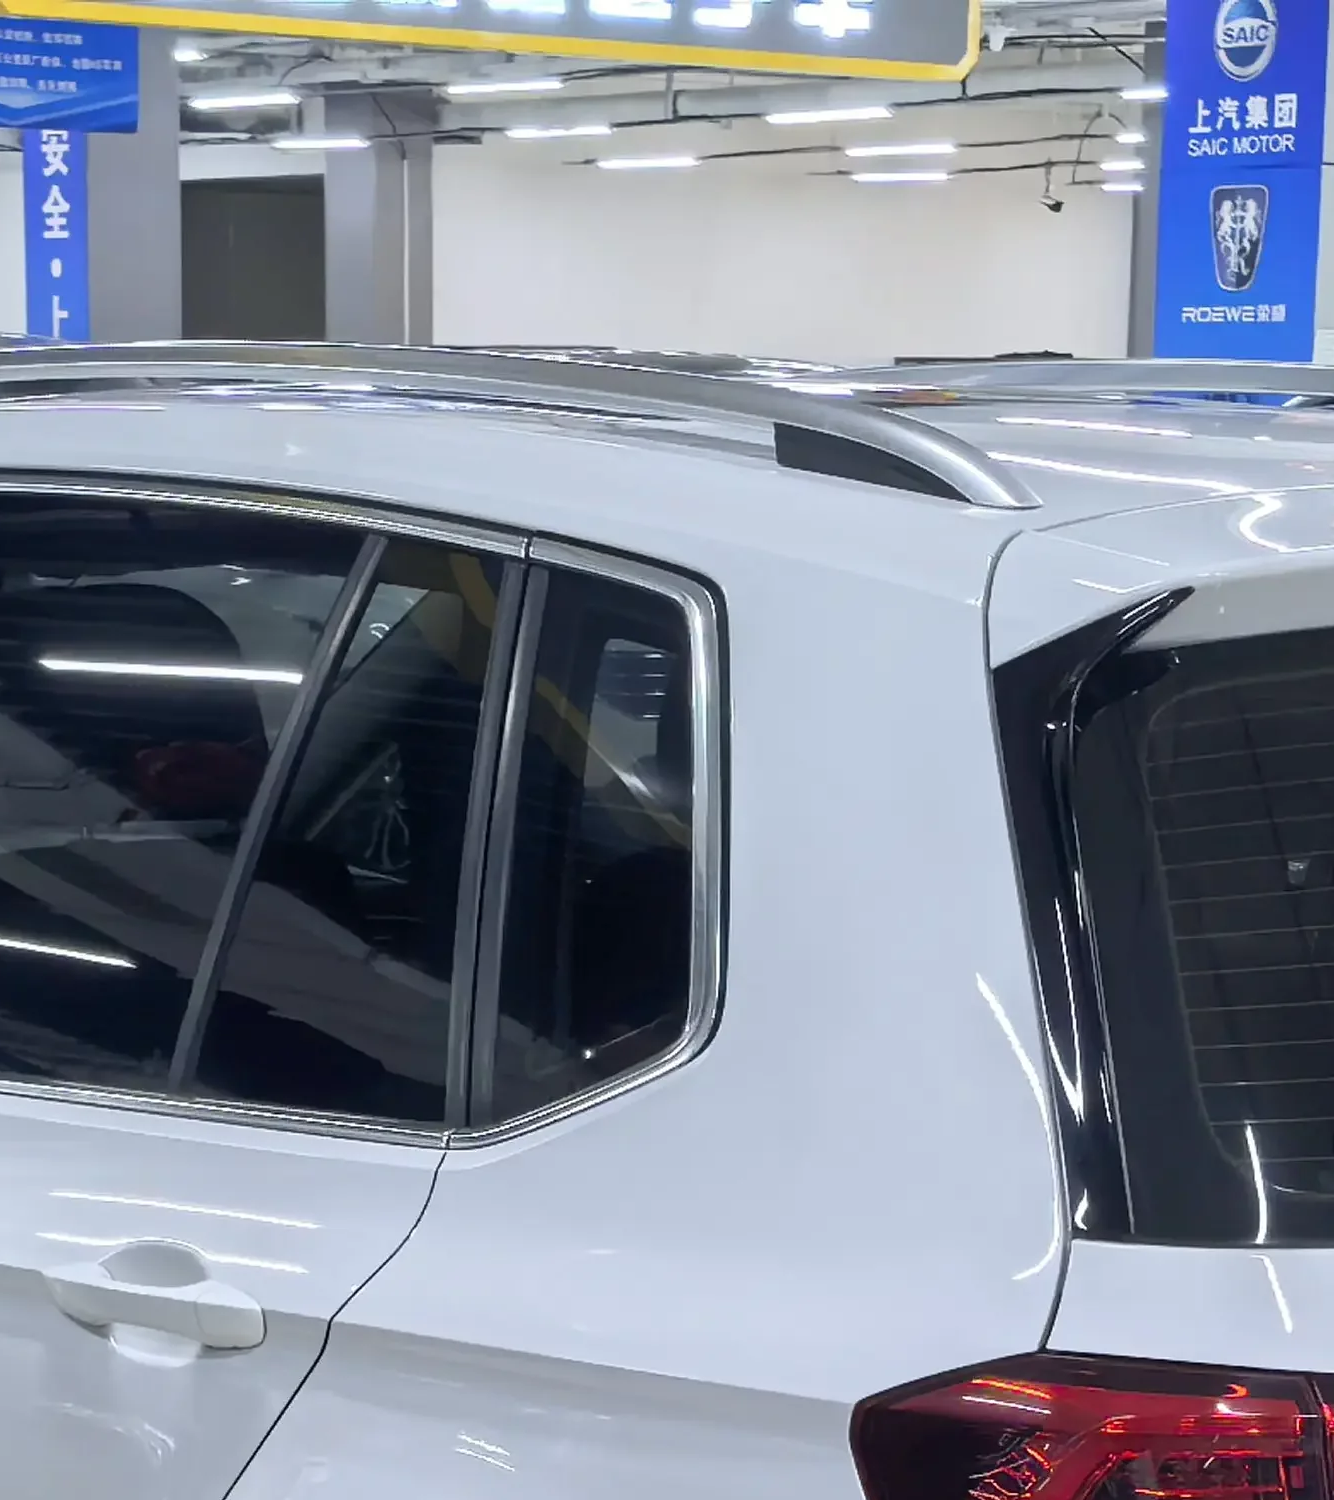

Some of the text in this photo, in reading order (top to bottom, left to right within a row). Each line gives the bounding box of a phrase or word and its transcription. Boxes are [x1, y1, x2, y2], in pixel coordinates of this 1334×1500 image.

[1222, 24, 1269, 44] SAIC
[1187, 92, 1299, 134] 上汽集团
[1187, 133, 1296, 157] SAIC MOTOR
